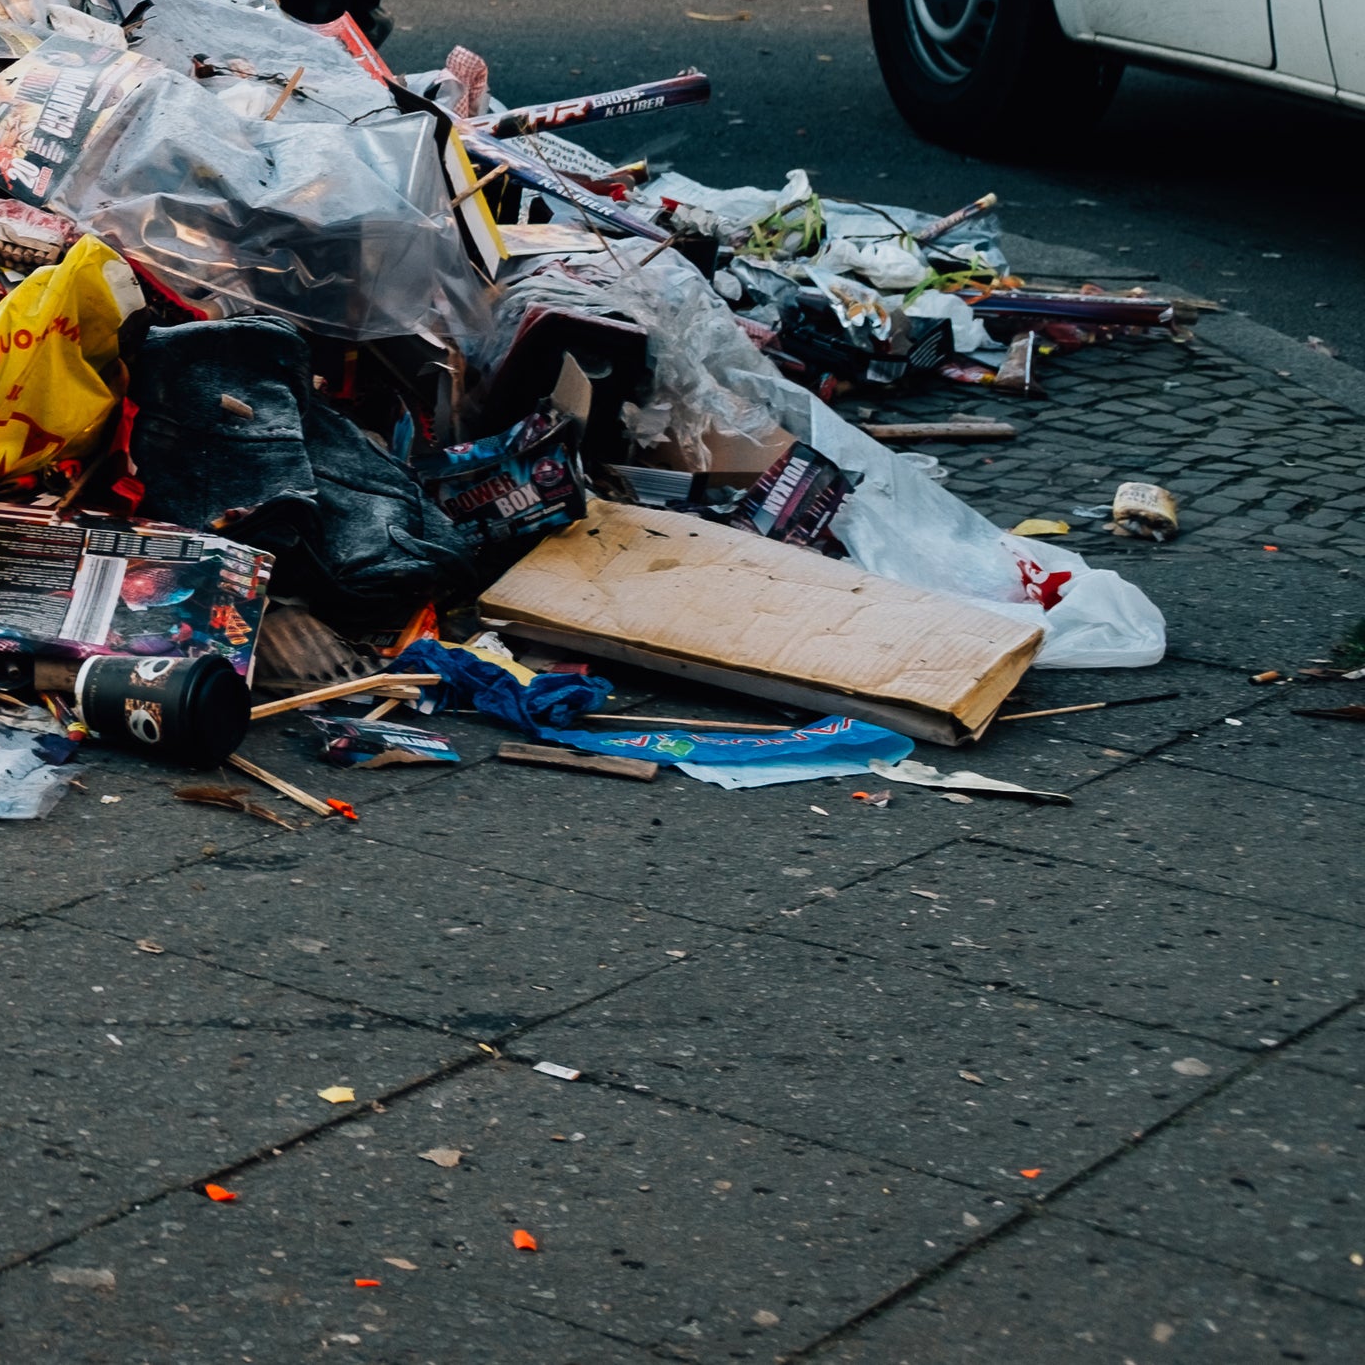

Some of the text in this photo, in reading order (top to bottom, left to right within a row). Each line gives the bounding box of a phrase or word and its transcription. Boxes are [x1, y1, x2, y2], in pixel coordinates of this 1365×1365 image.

[605, 95, 665, 118] KALIBER
[7, 157, 40, 189] 20
[537, 177, 615, 216] KALIBER
[445, 473, 516, 517] POWER
[496, 484, 541, 517] BOX
[762, 455, 810, 516] VULKAN
